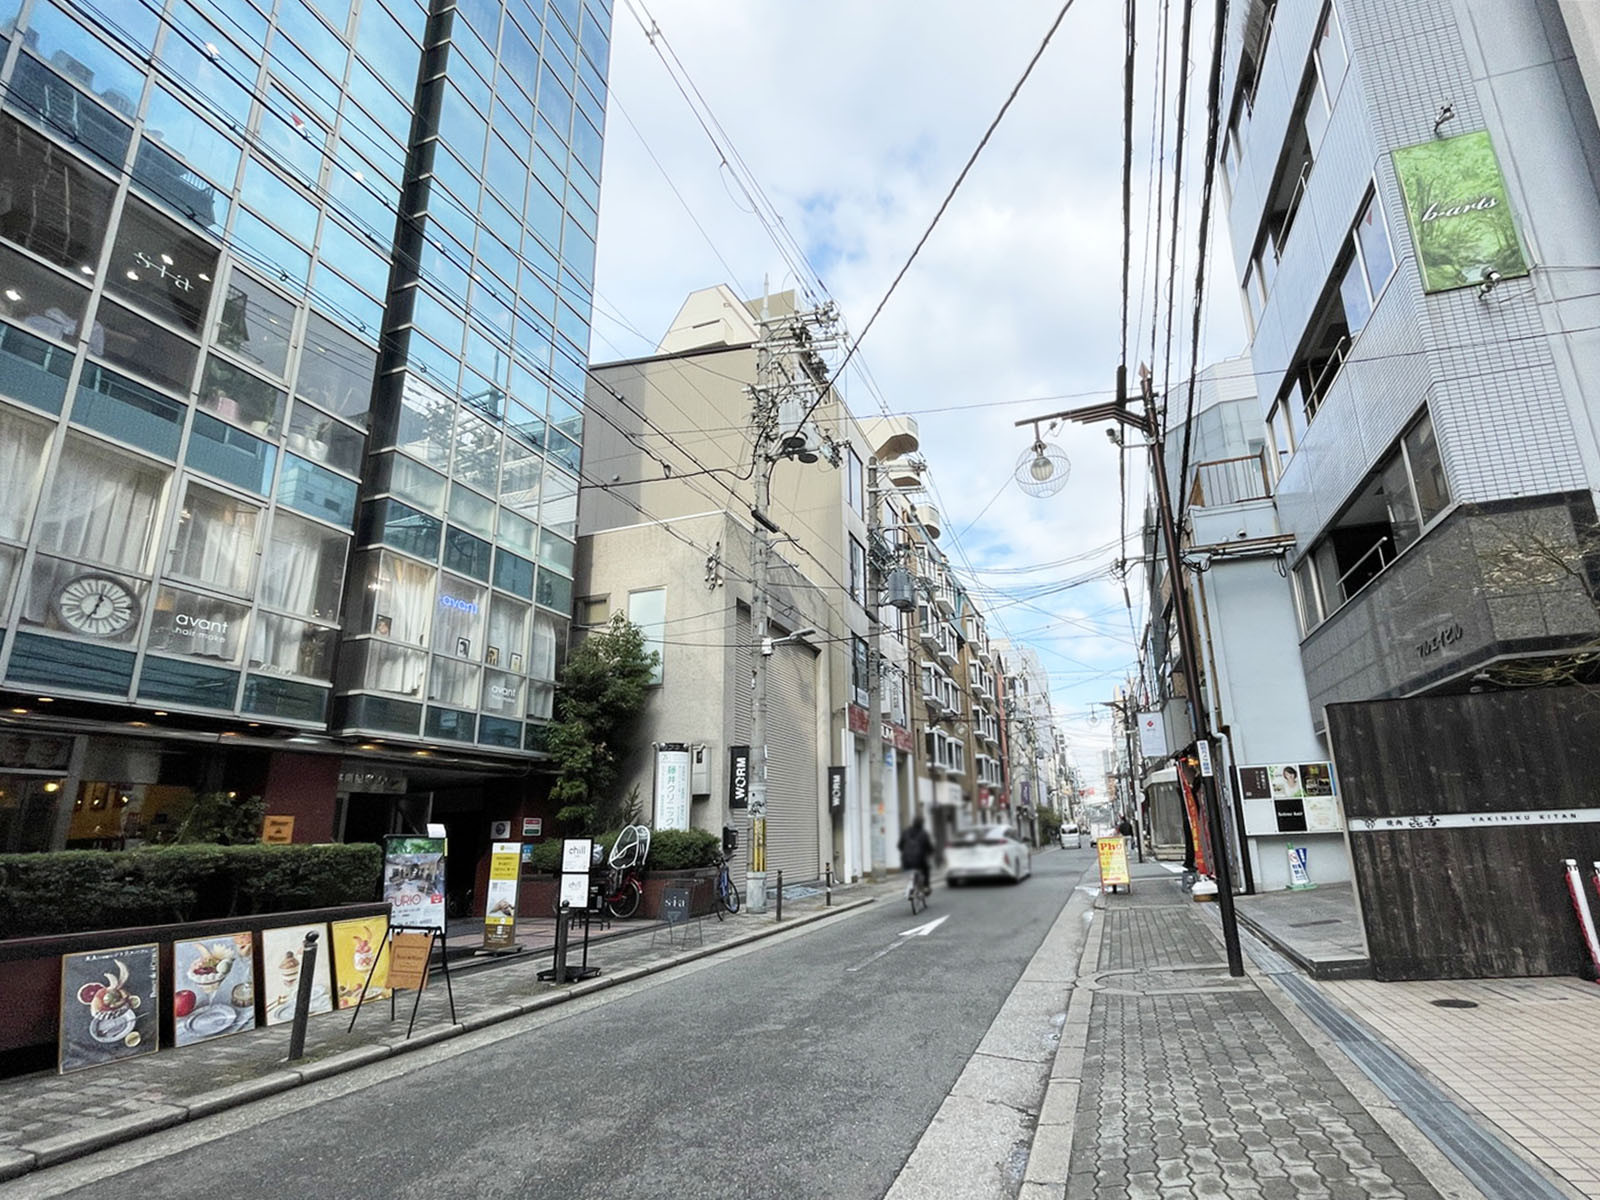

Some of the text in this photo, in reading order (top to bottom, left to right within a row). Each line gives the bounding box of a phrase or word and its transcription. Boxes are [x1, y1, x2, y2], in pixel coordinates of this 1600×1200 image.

[440, 595, 478, 614] avant
[175, 614, 228, 633] avant
[735, 757, 746, 800] WORM
[832, 774, 841, 807] WORM
[1471, 813, 1577, 823] YAKINIKU KITAN
[569, 845, 586, 855] chill
[665, 896, 685, 907] sia
